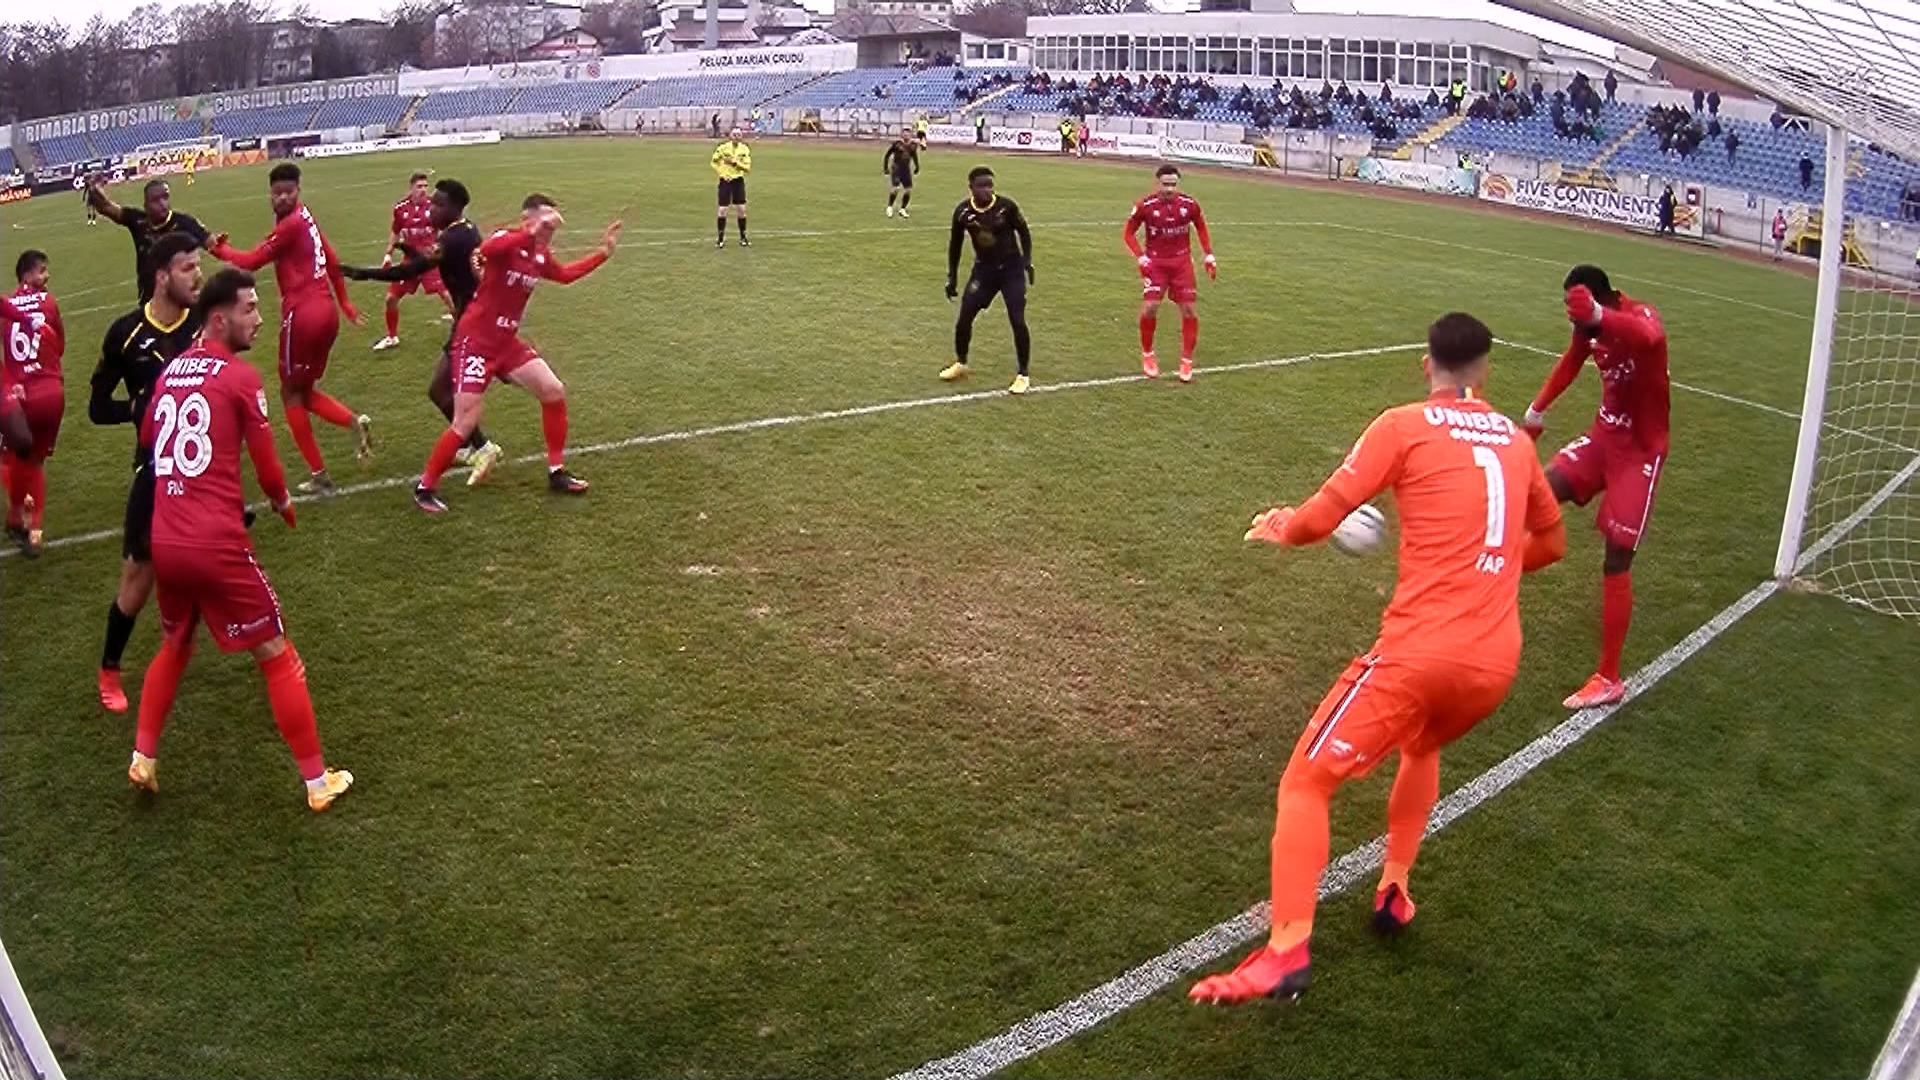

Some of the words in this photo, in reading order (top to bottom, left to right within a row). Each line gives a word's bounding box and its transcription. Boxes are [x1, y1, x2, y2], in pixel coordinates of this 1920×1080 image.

[699, 56, 733, 67] PELUZA
[736, 54, 770, 65] MARIAN
[772, 53, 804, 64] CRUDU
[214, 92, 282, 113] CONSILIUL
[286, 86, 326, 104] LOCAL
[329, 79, 396, 99] BOTOSANI
[89, 105, 163, 132] BOTOSANI
[1516, 179, 1550, 198] FIVE
[1554, 185, 1662, 217] CONTINENTS
[464, 356, 486, 378] 25
[154, 392, 213, 477] 28
[1423, 406, 1516, 436] UNIBET
[1472, 446, 1506, 548] 1
